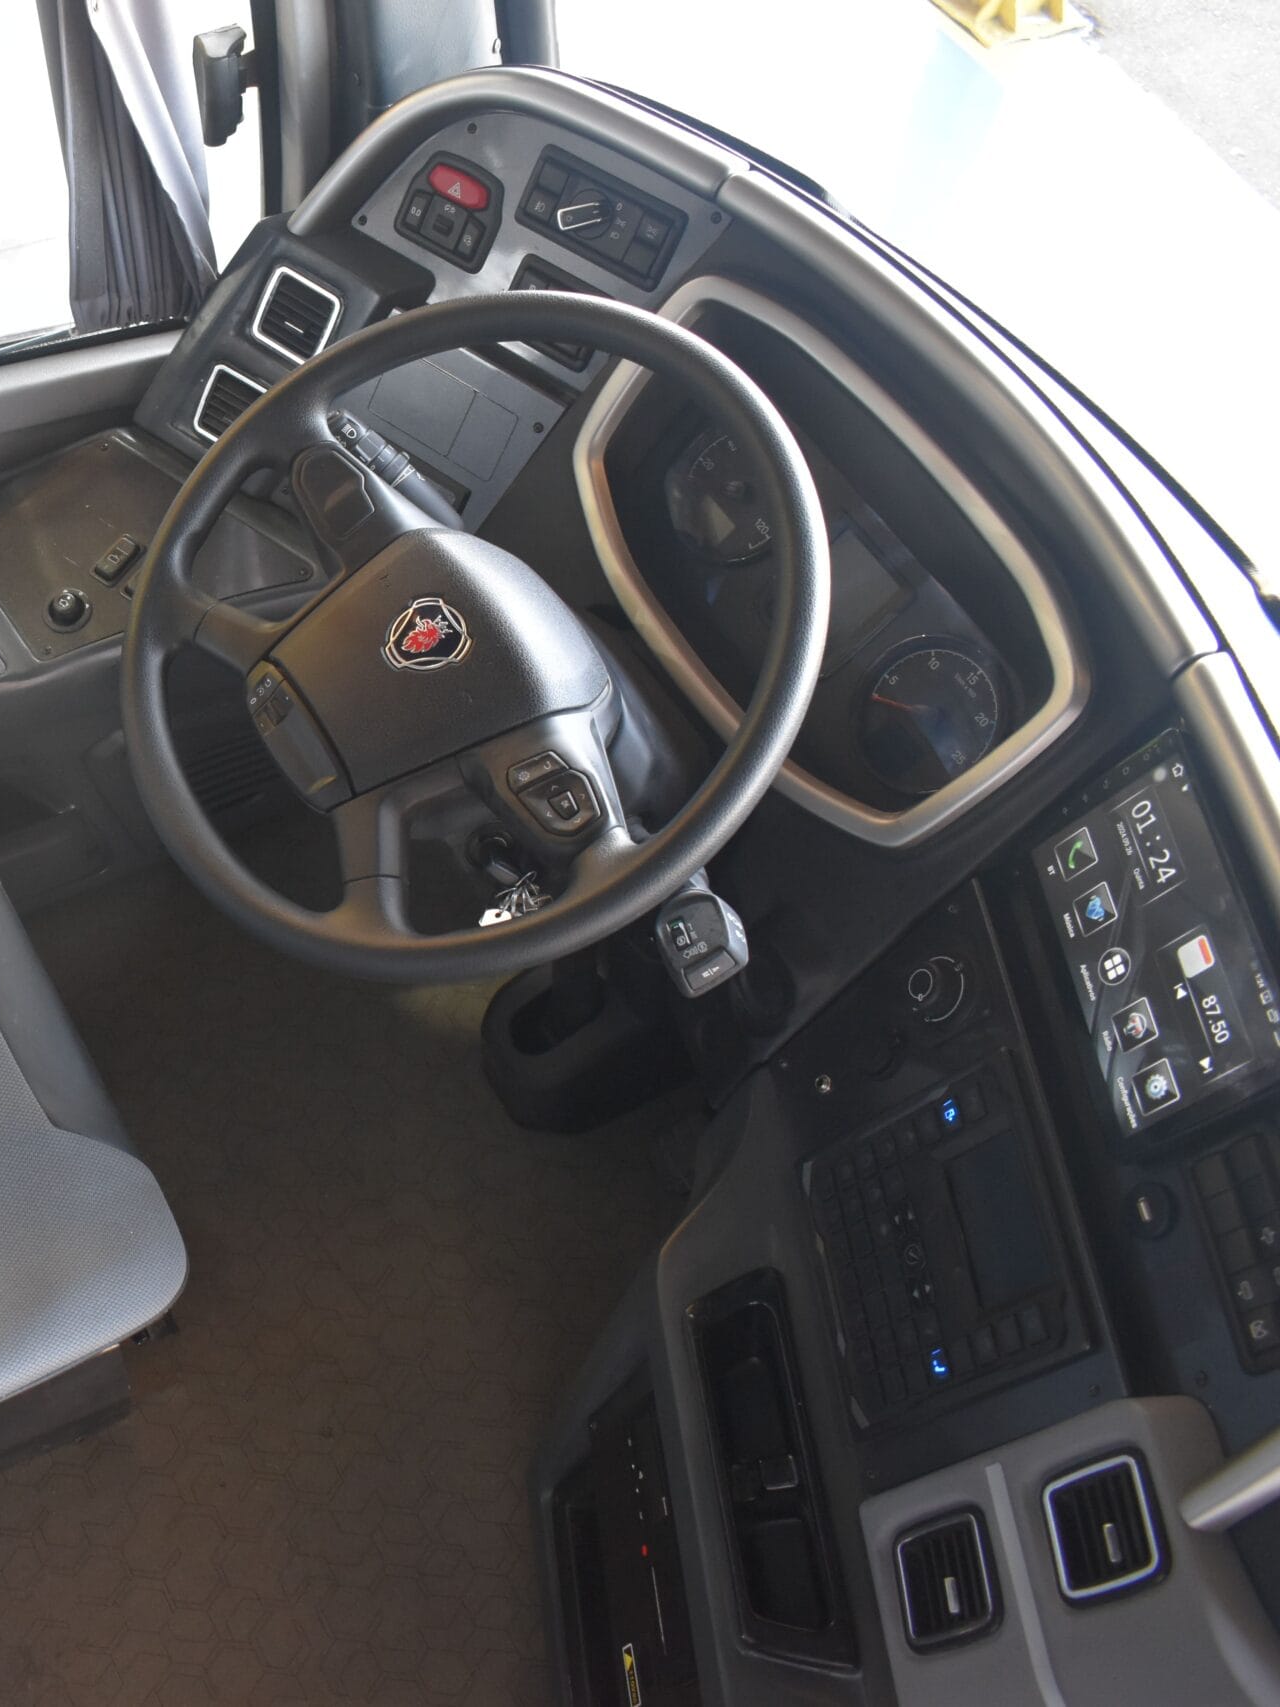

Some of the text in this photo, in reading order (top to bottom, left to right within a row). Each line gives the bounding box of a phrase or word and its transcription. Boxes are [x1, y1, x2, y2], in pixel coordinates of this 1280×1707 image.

[926, 657, 940, 671] 10
[889, 674, 900, 686] 5
[964, 671, 979, 686] 15
[974, 711, 990, 728] 20
[1046, 865, 1056, 876] BT
[1132, 867, 1145, 890] Quinta
[1079, 963, 1096, 1001] Aplicativos
[1201, 994, 1230, 1045] 87.50
[1116, 1076, 1139, 1130] Configurações
